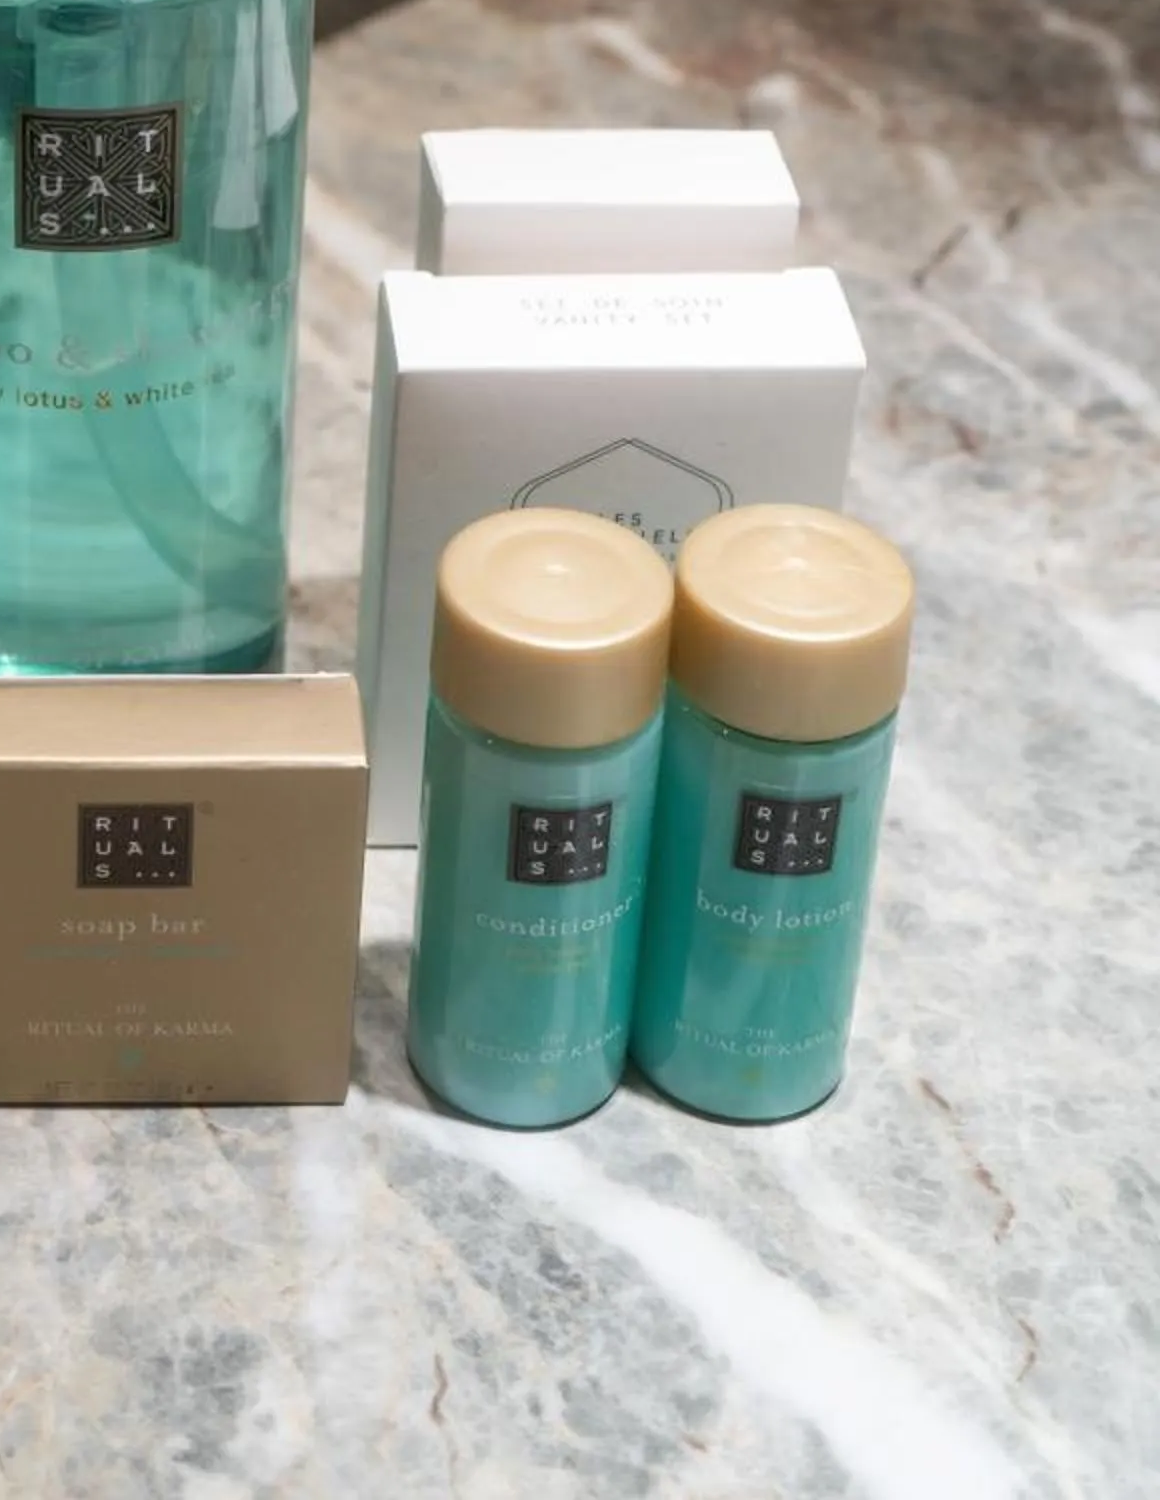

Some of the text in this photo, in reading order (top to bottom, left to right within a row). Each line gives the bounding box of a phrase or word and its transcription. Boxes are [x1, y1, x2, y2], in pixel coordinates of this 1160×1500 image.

[16, 386, 84, 409] lotus
[94, 388, 113, 409] &
[124, 380, 195, 406] white
[598, 511, 642, 527] ES
[475, 895, 634, 938] conditioner
[696, 886, 855, 933] body lotion
[60, 913, 206, 941] soap bar
[153, 1020, 234, 1036] KARMA
